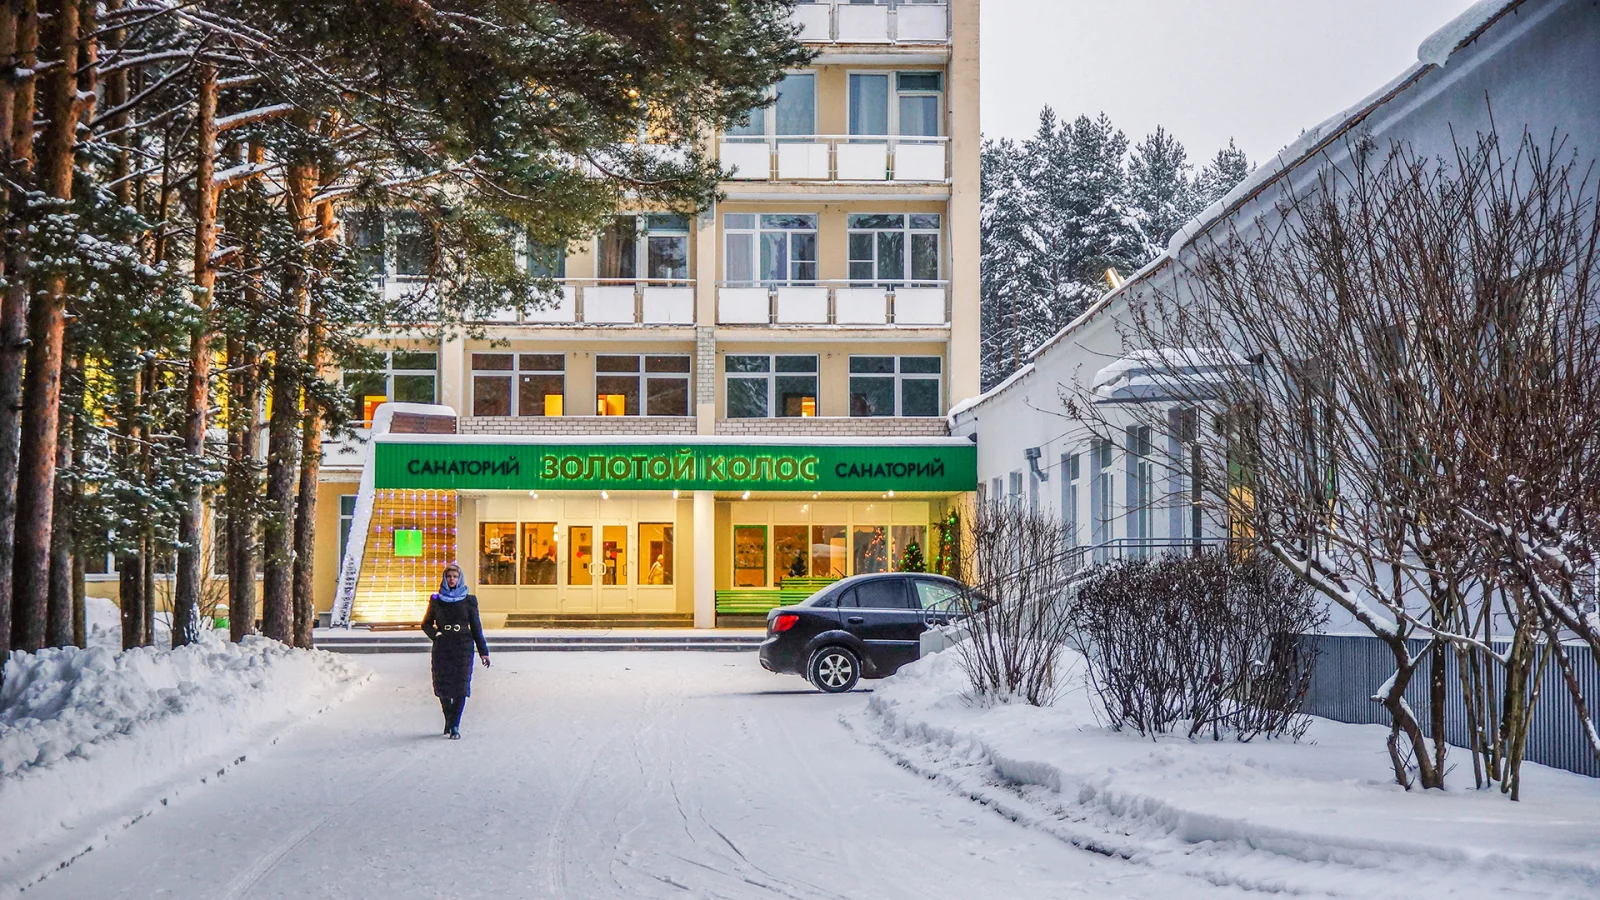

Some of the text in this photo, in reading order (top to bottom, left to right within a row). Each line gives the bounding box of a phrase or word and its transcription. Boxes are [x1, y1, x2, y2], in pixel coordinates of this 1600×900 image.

[407, 456, 520, 476] САНАТОРИЙ
[540, 448, 820, 481] ЗОЛОТОЙ КОЛОС
[835, 458, 945, 478] САНАТОРИЙ
